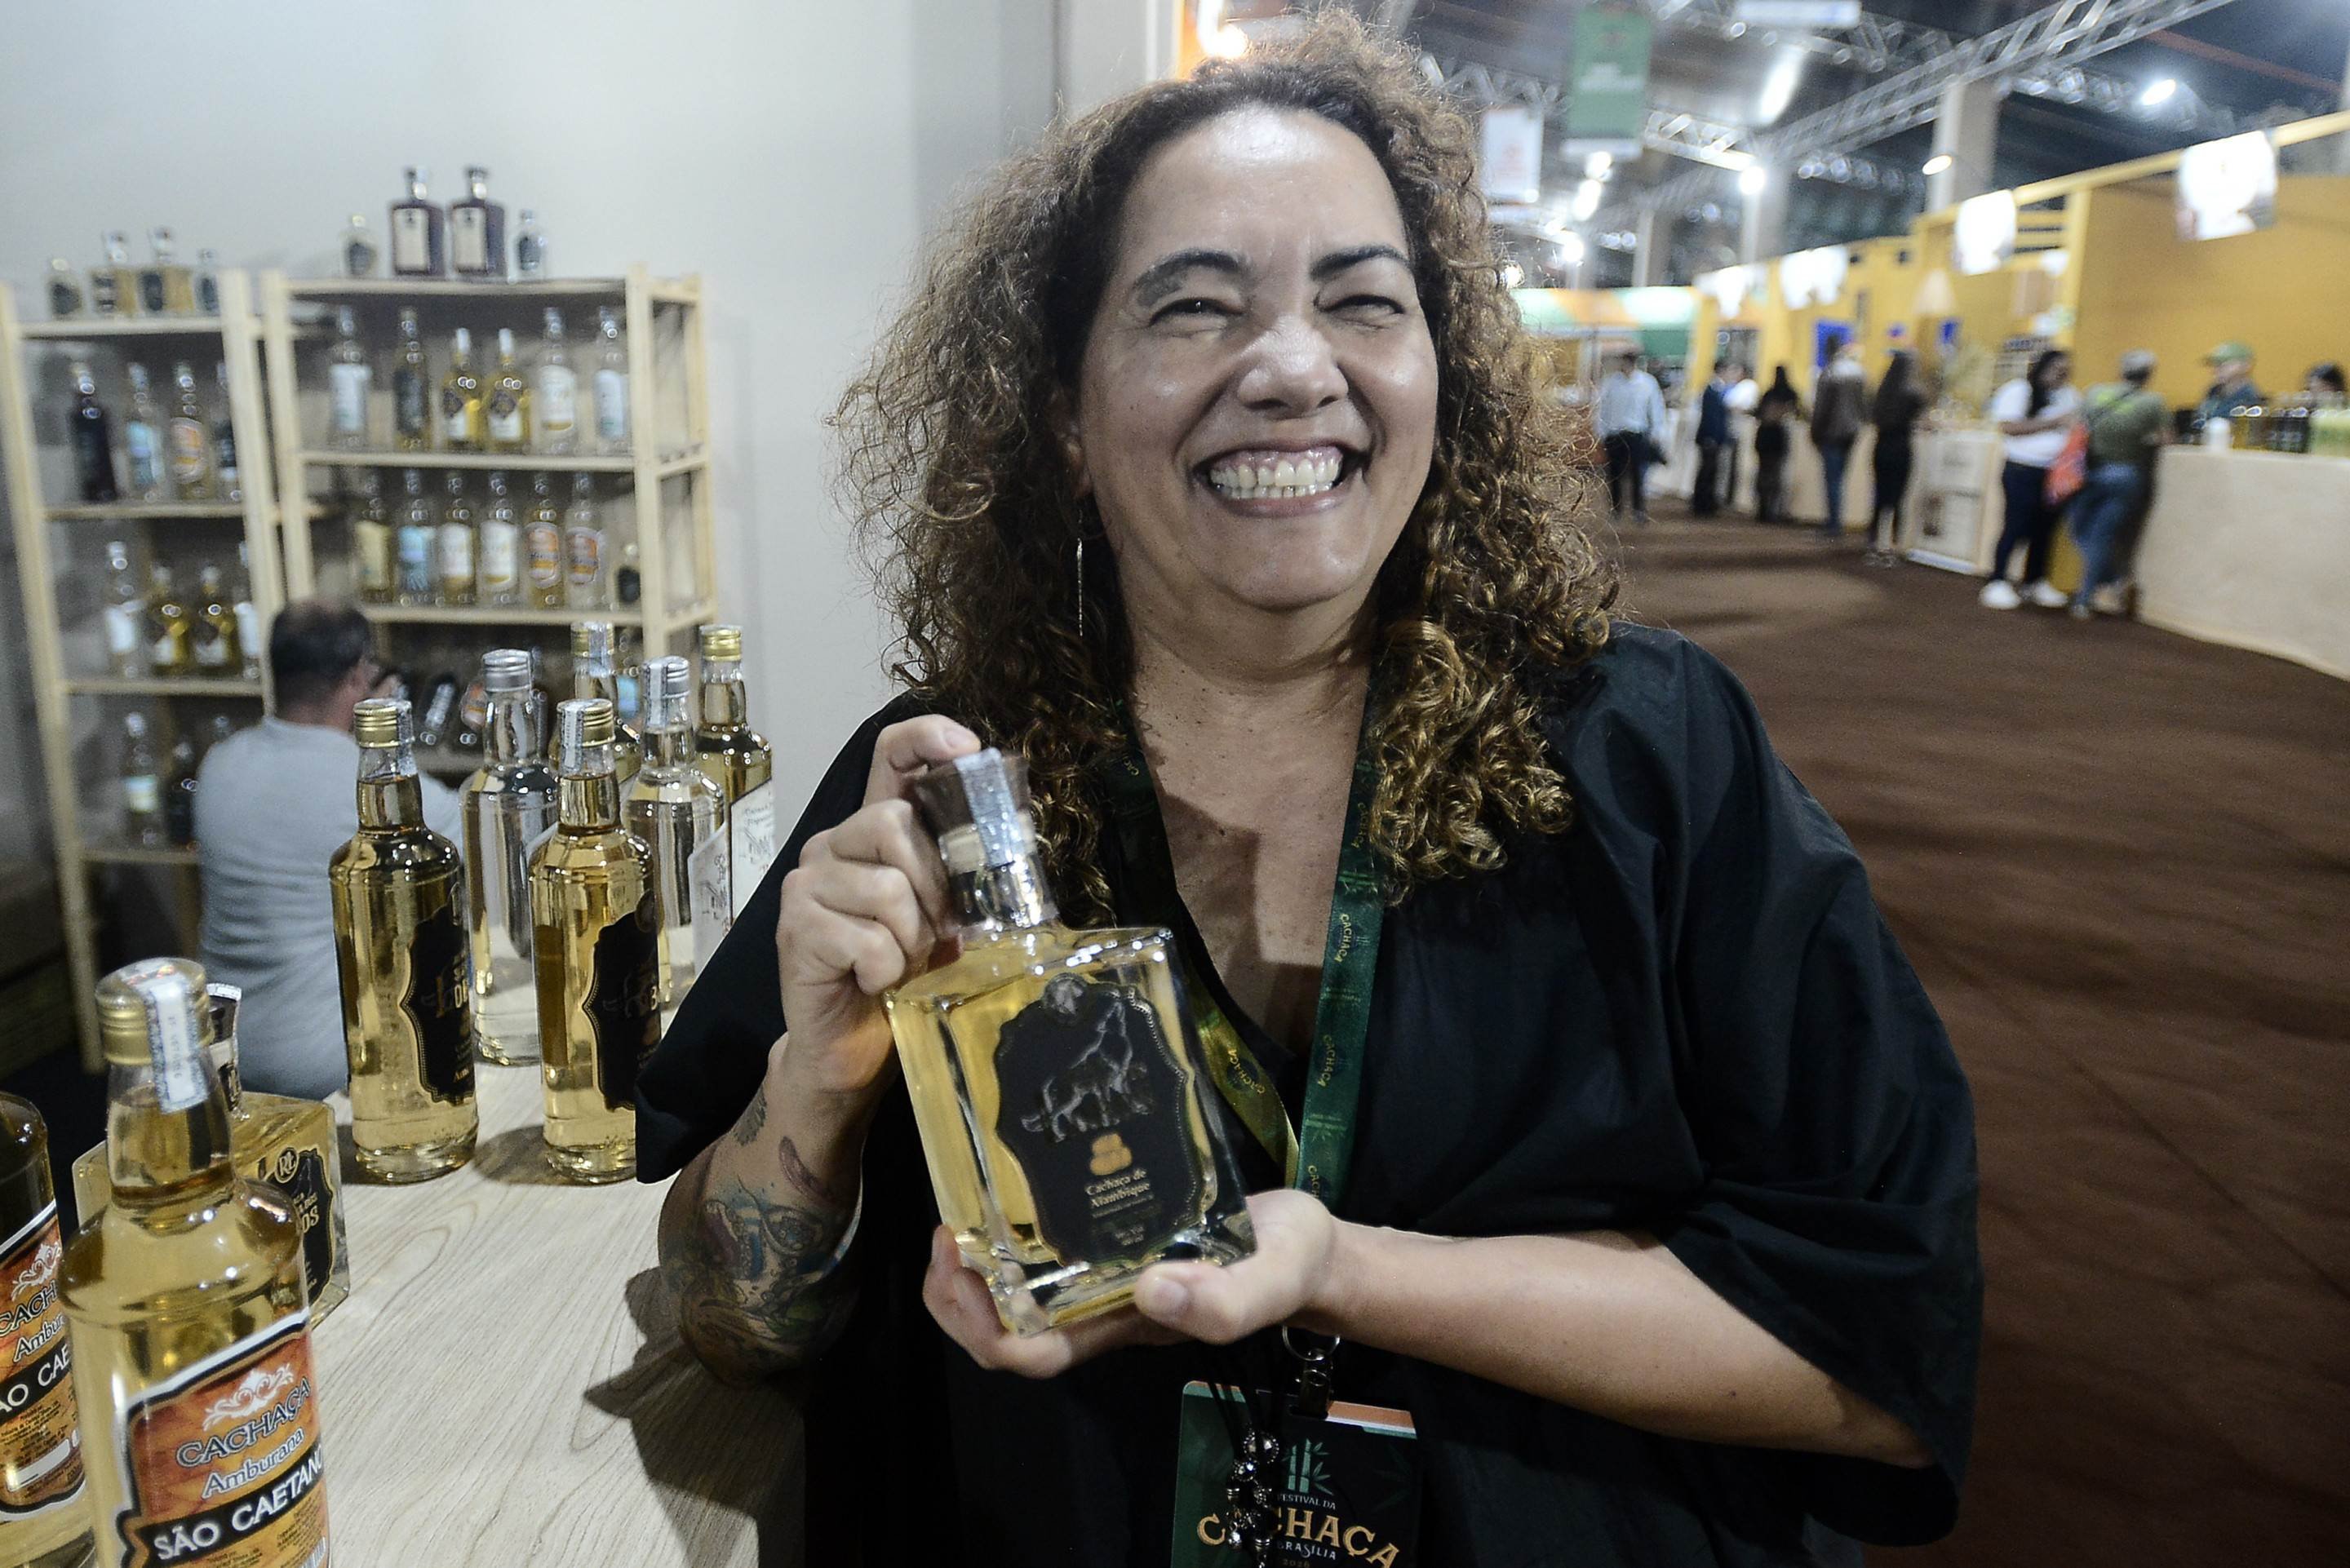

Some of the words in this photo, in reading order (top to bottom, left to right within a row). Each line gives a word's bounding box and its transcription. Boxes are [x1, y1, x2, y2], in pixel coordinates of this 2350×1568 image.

[1307, 1165, 1319, 1198] CACH
[0, 1279, 59, 1337] CACH
[12, 1312, 66, 1362] Ambur
[176, 1376, 311, 1468] CACHAÇA
[202, 1427, 304, 1500] Amburana
[1279, 1493, 1320, 1507] ESTIVAL
[1322, 1499, 1337, 1510] DA
[153, 1521, 220, 1560] SÃO
[1196, 1506, 1399, 1568] CHAÇA
[1279, 1539, 1337, 1561] RASÍLIA
